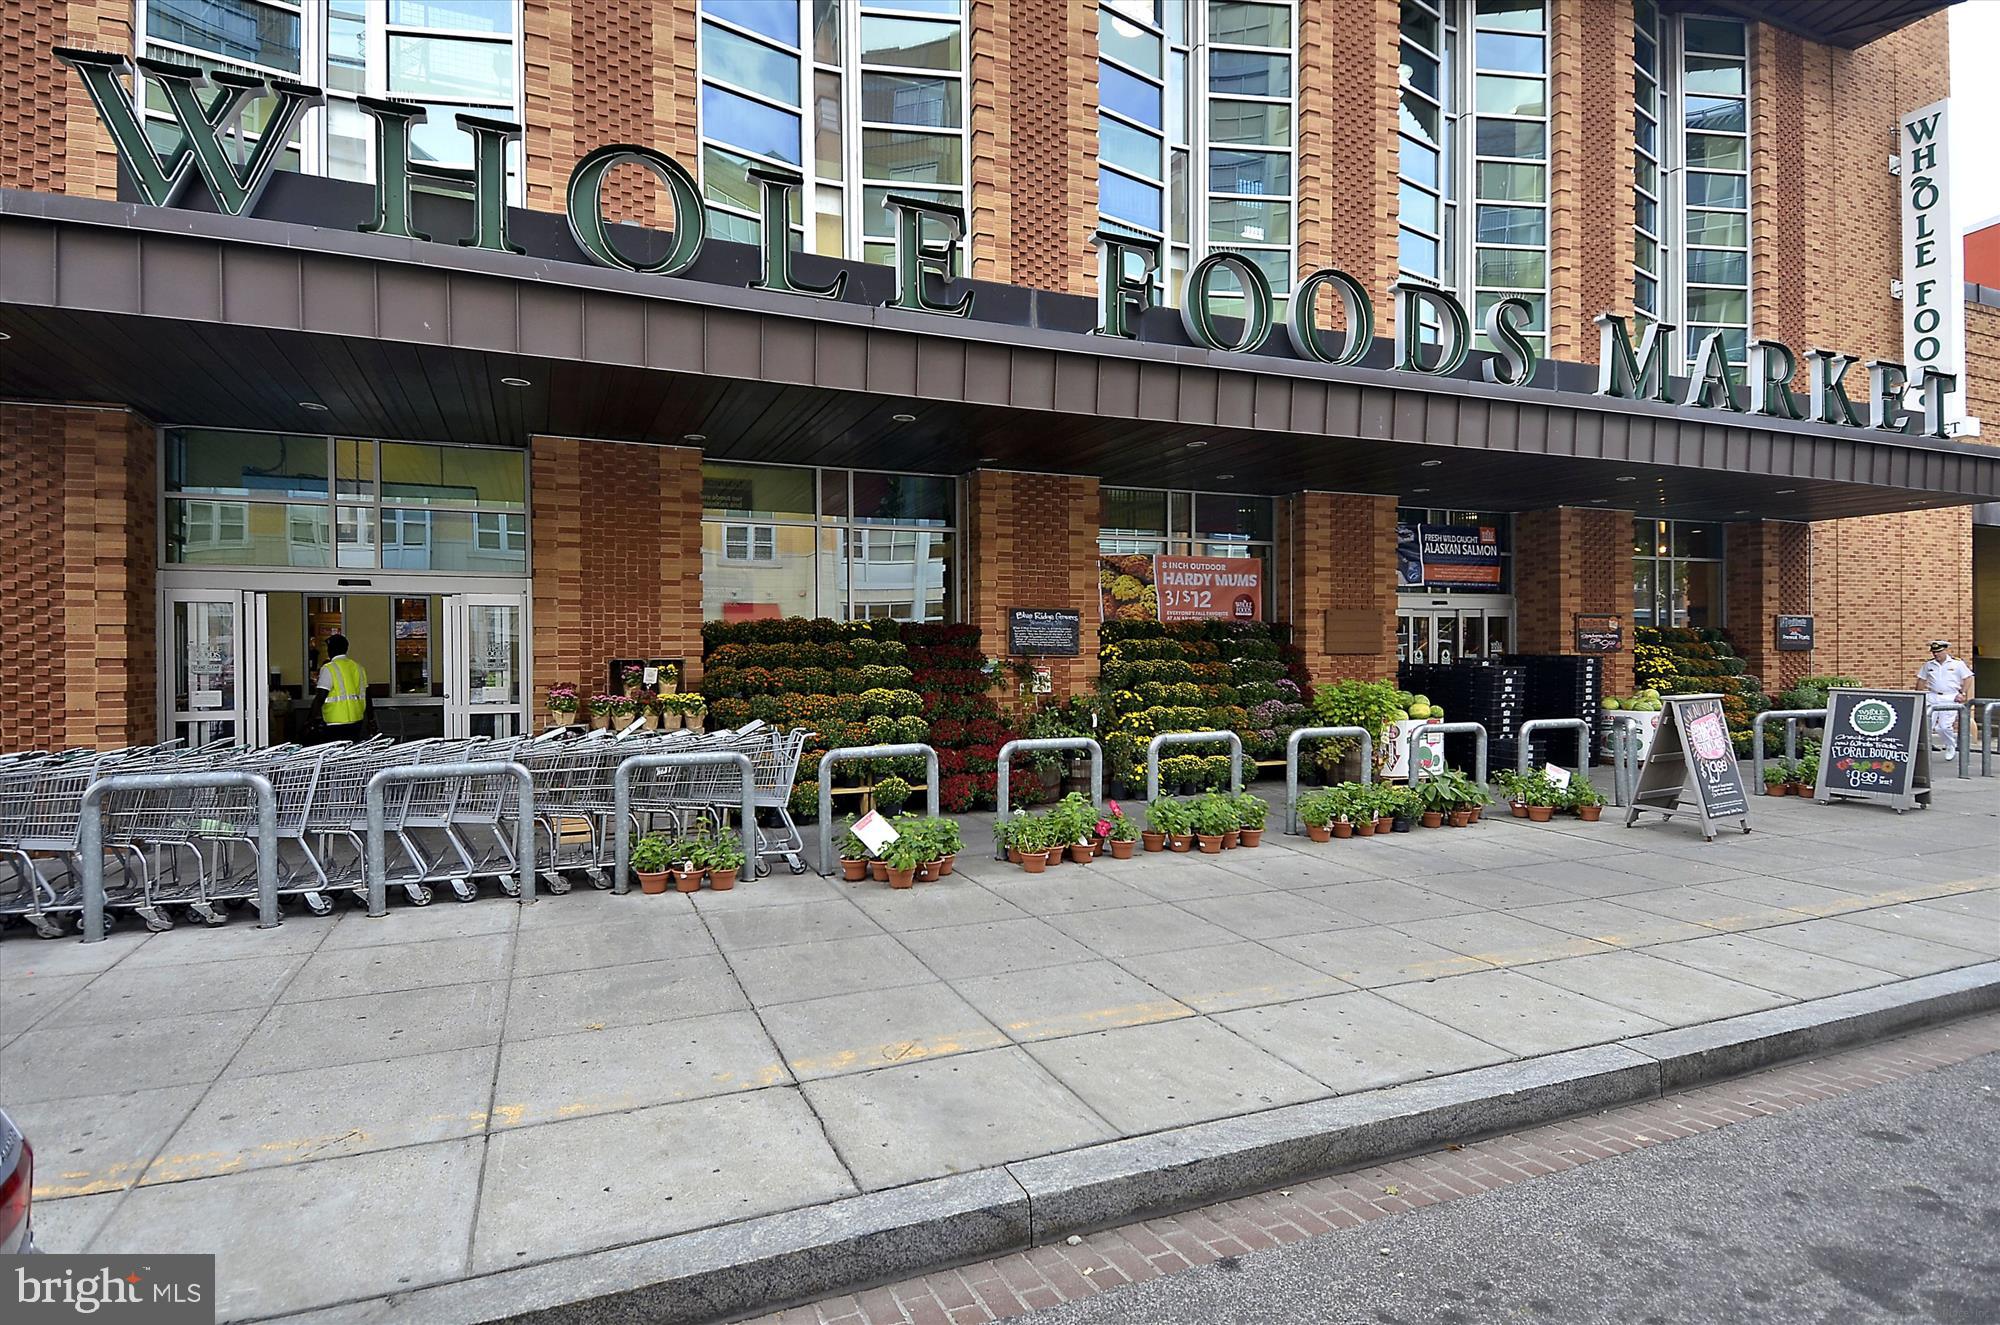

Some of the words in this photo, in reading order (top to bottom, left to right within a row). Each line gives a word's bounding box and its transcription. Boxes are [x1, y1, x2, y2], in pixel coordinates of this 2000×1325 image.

[1905, 111, 1942, 269] WHOLE
[52, 46, 976, 318] WHOLE
[1086, 230, 1536, 388] FOODS
[1592, 312, 1957, 440] MARKET
[1913, 279, 1941, 407] FOO
[1424, 533, 1442, 542] FRESH
[1442, 534, 1457, 543] WILD
[1457, 535, 1479, 544] CAUGHT
[1424, 543, 1461, 555] ALASKAN
[1462, 544, 1498, 556] SALMON
[1162, 561, 1168, 569] 8
[1169, 562, 1189, 570] INCH
[1190, 562, 1226, 571] OUTDOOR
[1162, 572, 1213, 586] HARDY
[1215, 574, 1258, 587] MUMS
[1034, 611, 1054, 622] Ridge
[1858, 708, 1885, 716] WHOLE
[1832, 746, 1868, 759] FLORAL
[1869, 747, 1909, 763] BOUQUETS
